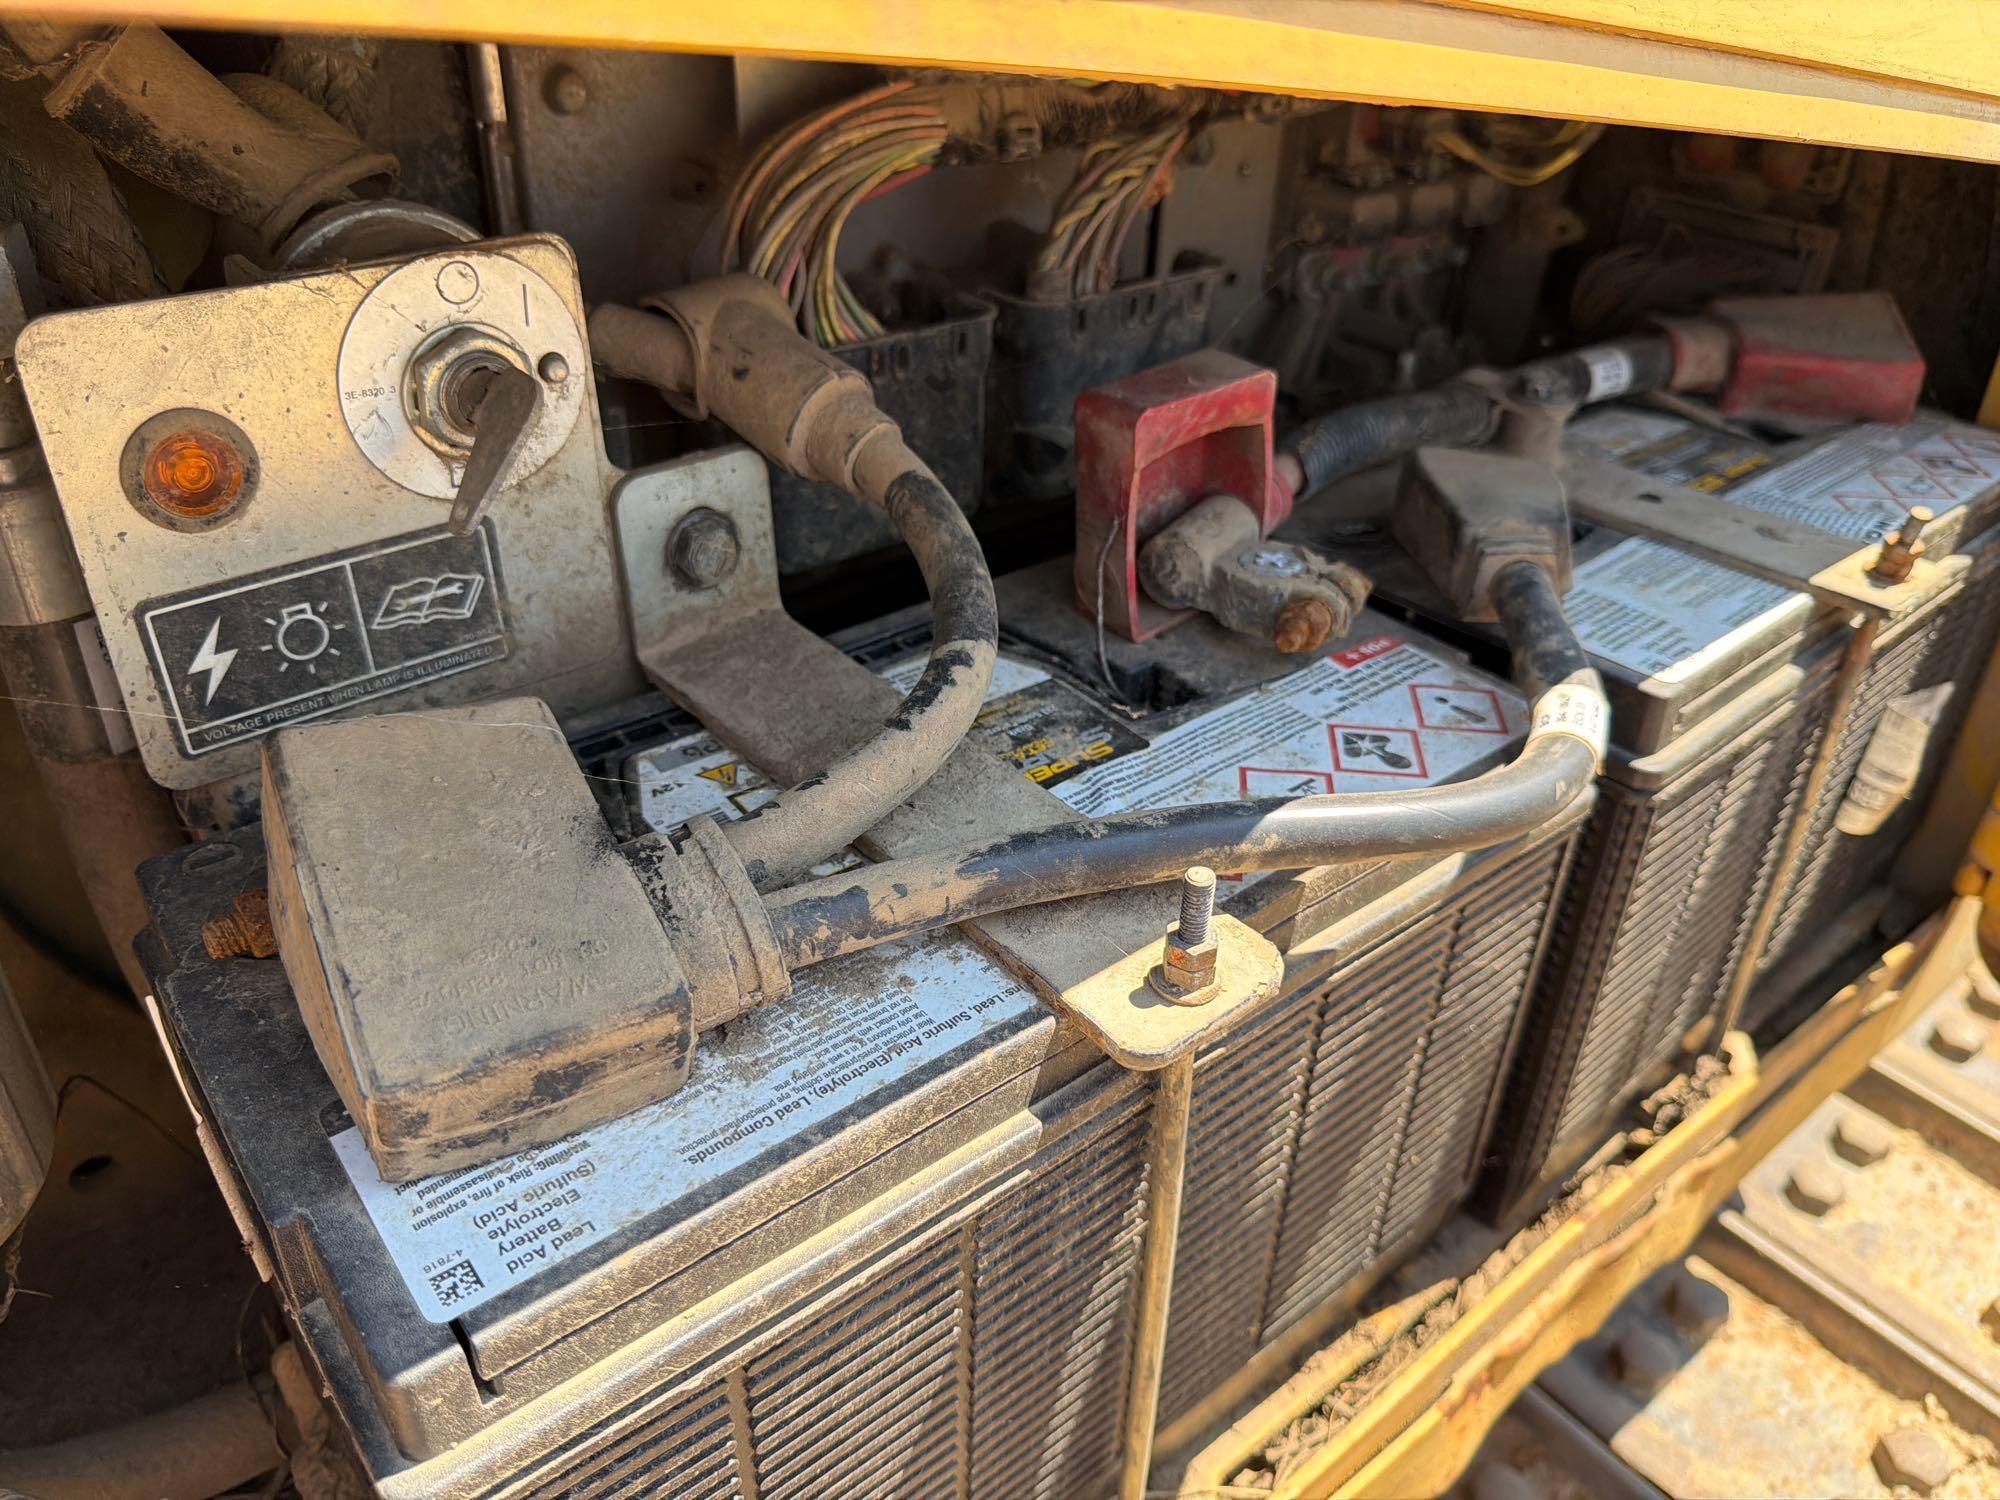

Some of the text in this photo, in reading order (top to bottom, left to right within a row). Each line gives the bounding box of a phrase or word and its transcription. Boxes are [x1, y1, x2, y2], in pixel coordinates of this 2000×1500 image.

[203, 644, 493, 743] VOLTAGE PRESENT WHEN LAMP IS ILLUMINATED
[439, 972, 596, 1034] WARNING
[887, 999, 901, 1012] not
[898, 1001, 919, 1018] Avoid
[899, 993, 911, 1006] Do
[967, 991, 1002, 1019] Lead,
[849, 1005, 868, 1020] from
[860, 1005, 889, 1026] breathe
[873, 1011, 900, 1031] contact
[895, 1013, 913, 1030] only
[911, 1008, 927, 1022] Use
[915, 1016, 935, 1032] Wear
[857, 1024, 875, 1039] with
[865, 1023, 898, 1046] outdoors
[880, 1024, 916, 1050] protective
[921, 1010, 970, 1043] Sulfuric
[812, 1047, 831, 1062] acid.
[849, 1043, 859, 1054] in
[893, 1035, 923, 1058] Acid
[821, 1041, 883, 1082] gloves/protective
[789, 1073, 824, 1098] clothing,
[774, 1095, 809, 1121] Lead
[775, 1090, 792, 1106] eye
[681, 1111, 774, 1169] Compounds.
[410, 1137, 591, 1233] WARNING: Risk of fire, explosion
[424, 1168, 496, 1212] disassemble
[470, 1157, 597, 1232] (Sulfuric Acid)
[409, 1204, 424, 1218] or
[484, 1186, 581, 1243] Electrolyte
[494, 1215, 561, 1258] Battery
[504, 1219, 595, 1275] Lead Acid
[421, 1247, 464, 1274] 4-7816
